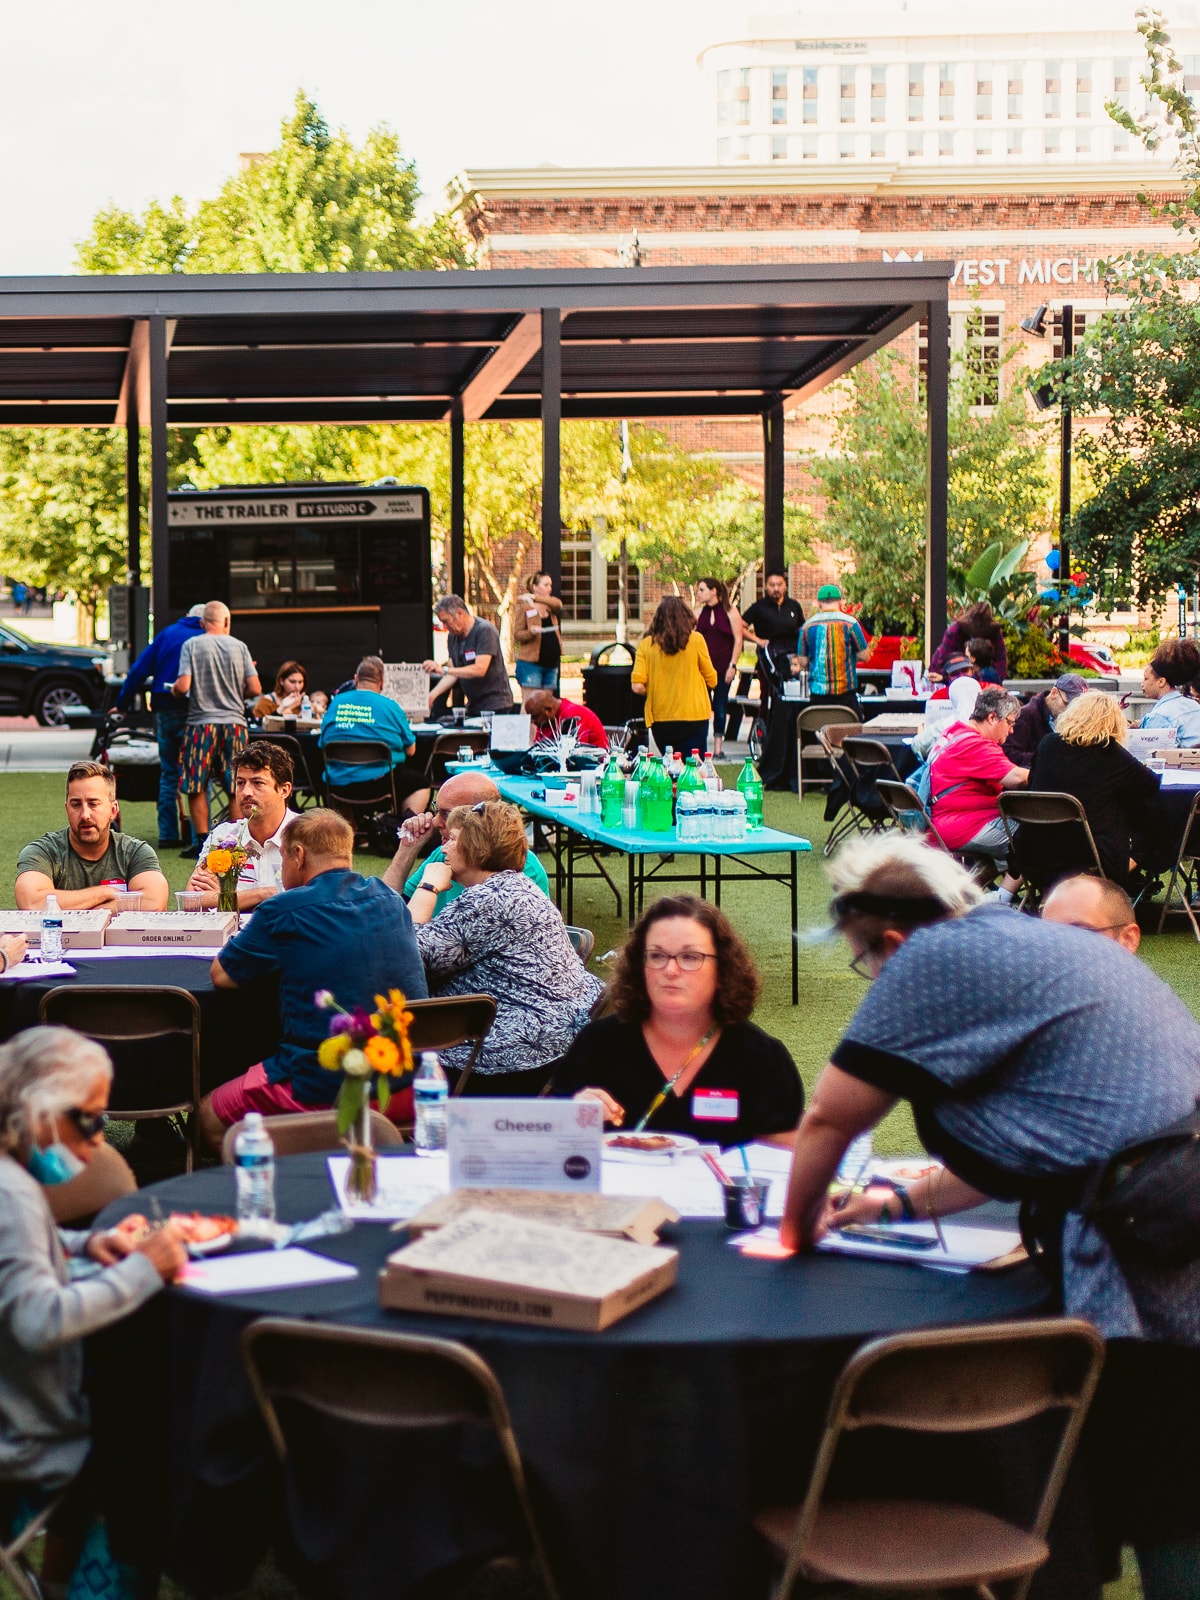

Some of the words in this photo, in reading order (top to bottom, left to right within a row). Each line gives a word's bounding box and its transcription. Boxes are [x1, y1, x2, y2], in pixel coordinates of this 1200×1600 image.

[195, 505, 224, 518] THE
[226, 503, 289, 518] TRAILER
[300, 505, 315, 515] BY
[316, 503, 357, 515] STUDIO
[358, 502, 367, 513] C
[494, 1118, 553, 1132] Cheese
